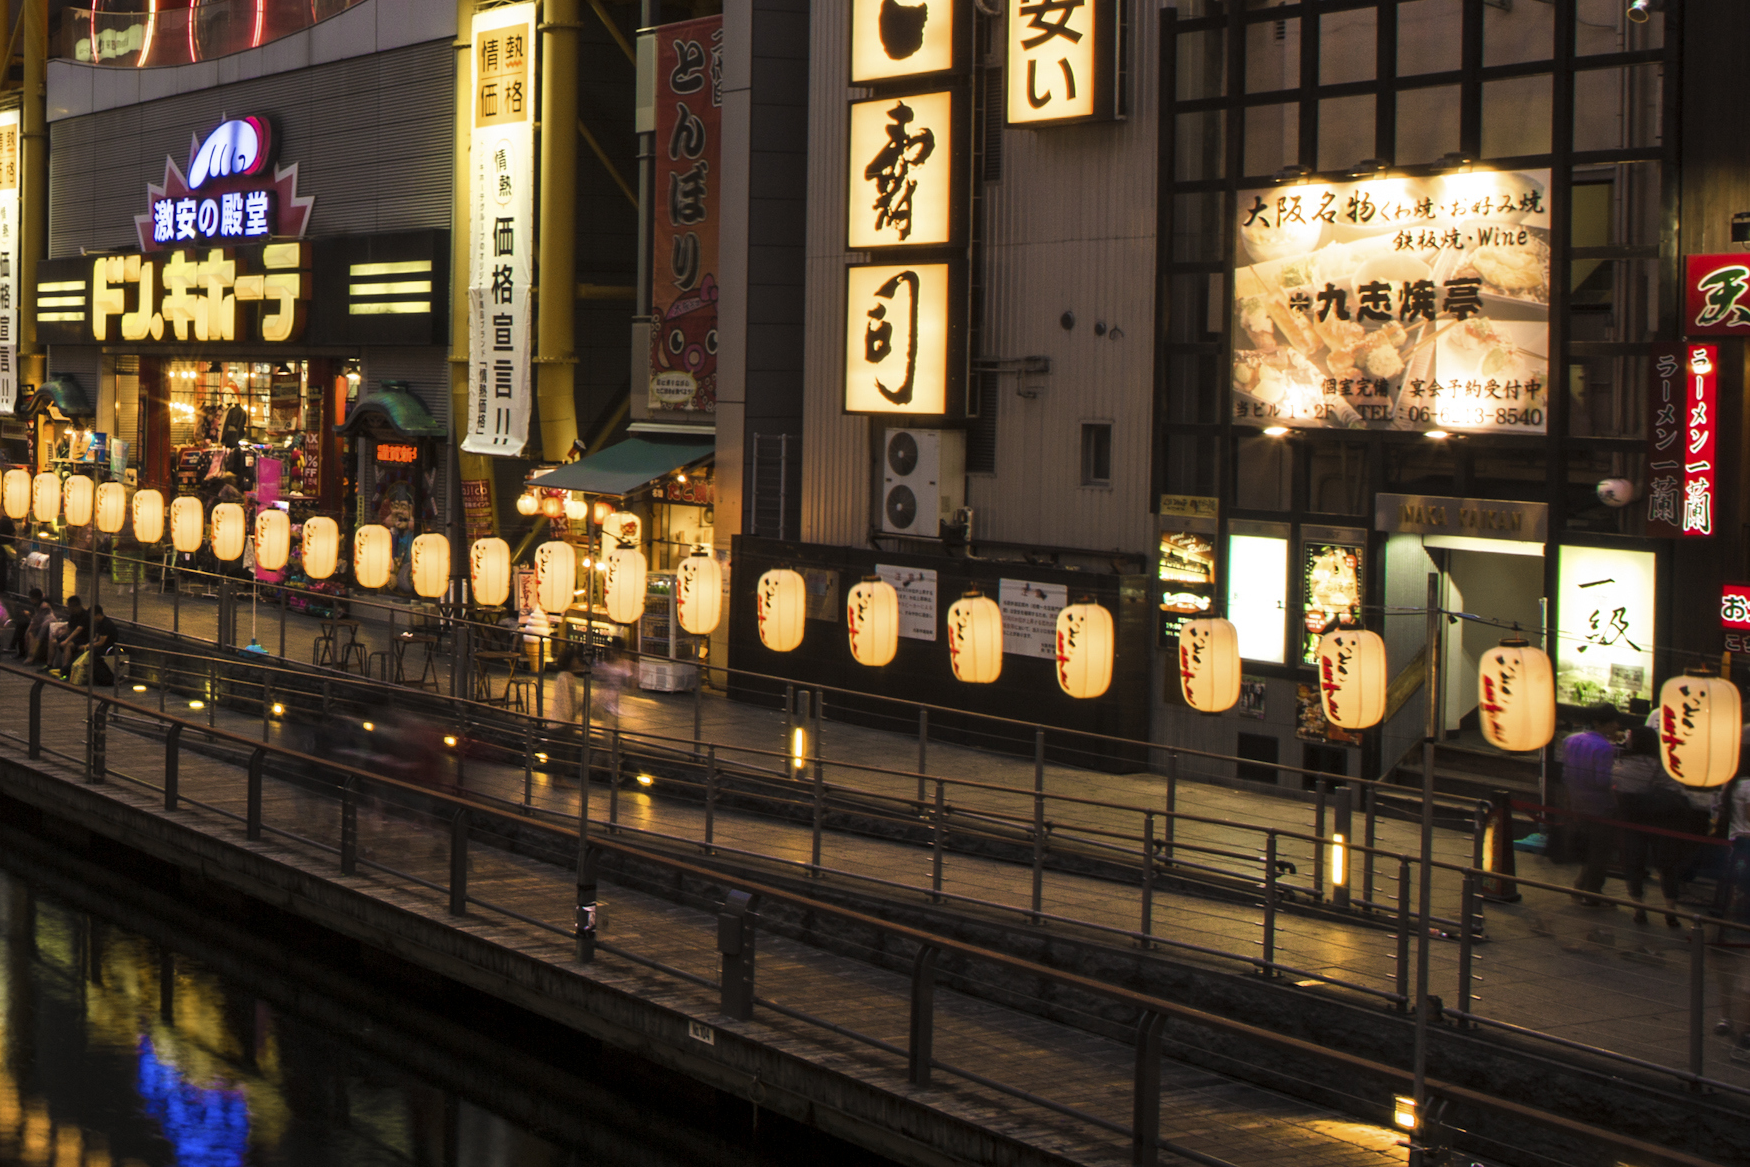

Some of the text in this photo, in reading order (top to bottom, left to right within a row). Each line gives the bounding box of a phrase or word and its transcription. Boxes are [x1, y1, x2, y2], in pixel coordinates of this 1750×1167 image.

[480, 34, 524, 73] 情熱
[479, 80, 524, 119] 価格
[668, 38, 709, 293] とんぼり
[153, 191, 269, 243] 激安の殿堂
[1242, 189, 1546, 228] 大阪名物 くわ焼・お好み焼
[1392, 226, 1529, 251] 鉄板焼・Wine
[490, 148, 515, 446] 情熱 価格宣言!!
[1315, 276, 1484, 323] 九志焼亭
[1321, 378, 1543, 400] 個室完備・宴会予約受付中
[1647, 354, 1680, 527] ラーメン一蘭
[1682, 347, 1712, 534] ラーメン一蘭
[1575, 577, 1643, 654] 一級
